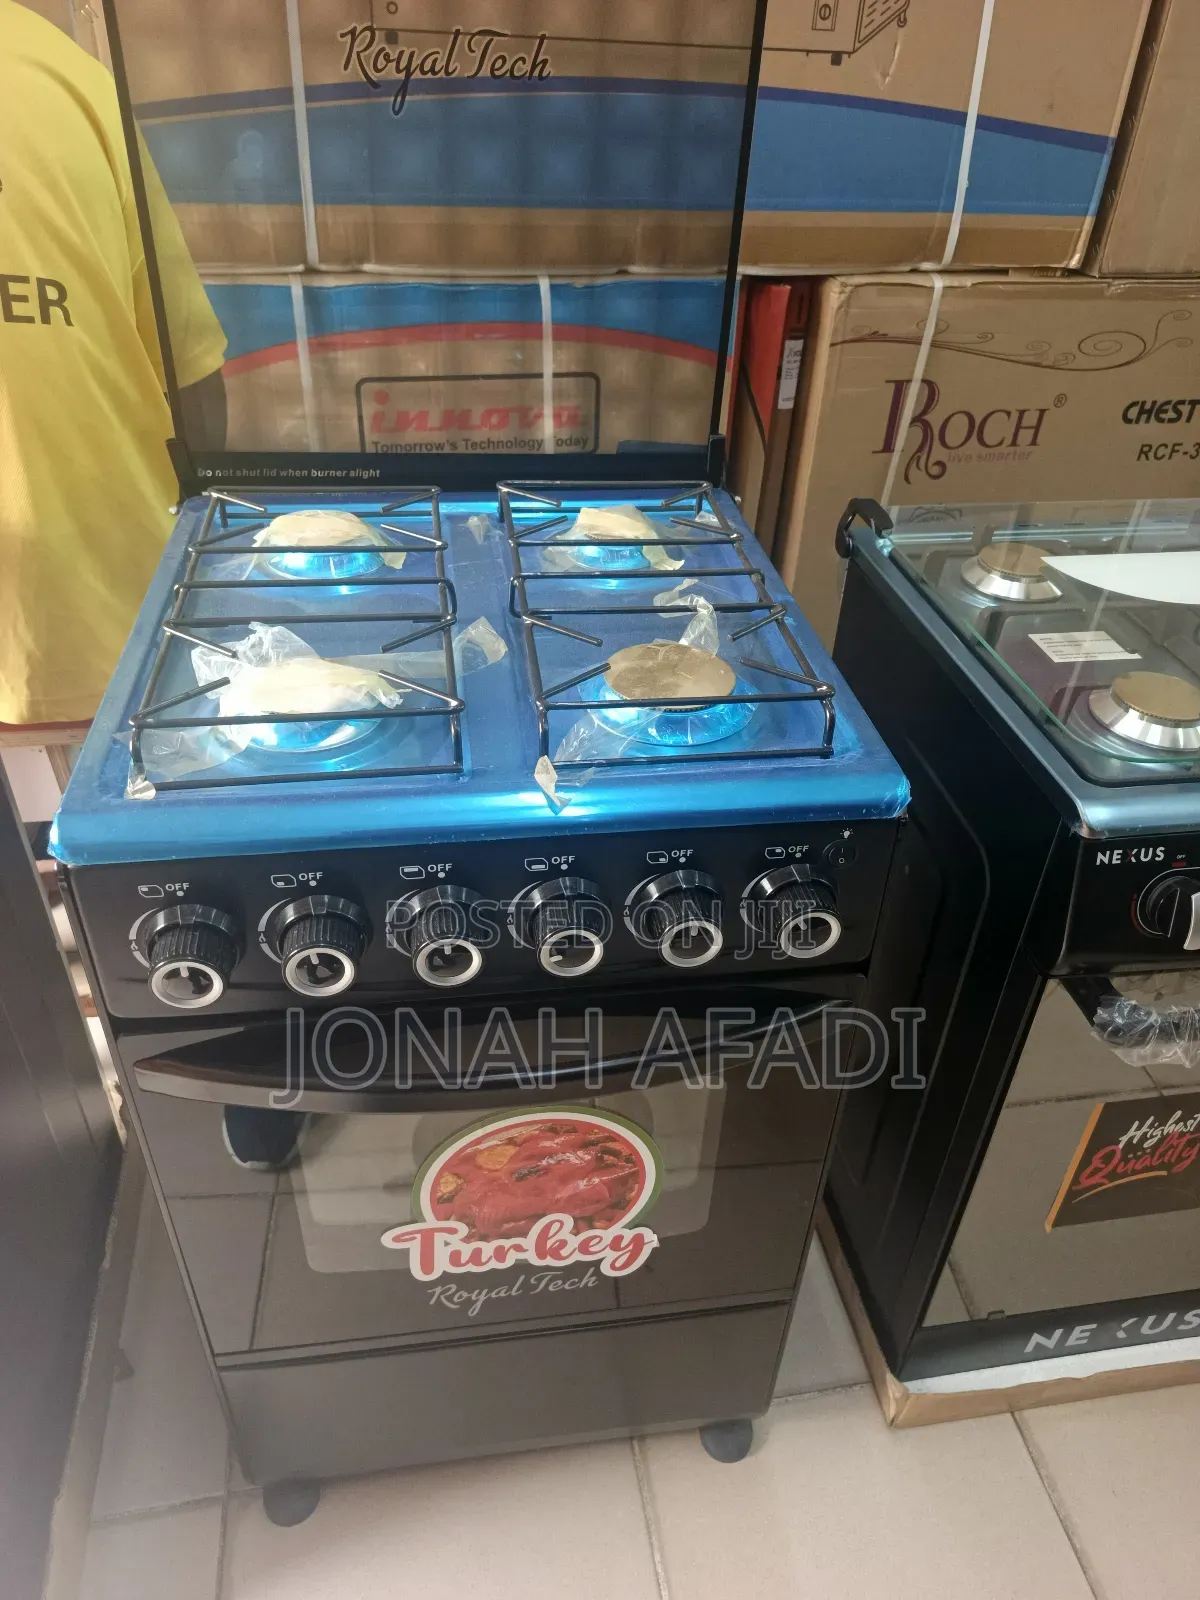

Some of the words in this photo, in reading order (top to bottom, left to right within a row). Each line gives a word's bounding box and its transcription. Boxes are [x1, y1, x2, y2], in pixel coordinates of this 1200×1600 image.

[339, 25, 460, 116] Royal
[467, 28, 552, 82] Tech
[1121, 399, 1200, 425] CHEST
[872, 379, 1050, 485] ROCH
[371, 439, 458, 453] Tomorrow's
[462, 435, 544, 450] Technology
[550, 435, 589, 449] oday
[197, 468, 213, 477] Do
[215, 468, 234, 477] not
[236, 468, 261, 477] shut
[263, 468, 277, 477] lid
[279, 468, 308, 477] when
[311, 468, 347, 477] burner
[350, 468, 380, 480] alight
[671, 849, 694, 858] OFF
[788, 845, 810, 854] OFF
[1095, 846, 1166, 866] NEXUS
[551, 855, 576, 865] OFF
[427, 863, 453, 873] OFF
[298, 872, 324, 882] OFF
[165, 882, 190, 892] OFF
[391, 1218, 656, 1276] Turkey
[427, 1275, 523, 1317] Royal
[529, 1267, 599, 1295] Tech
